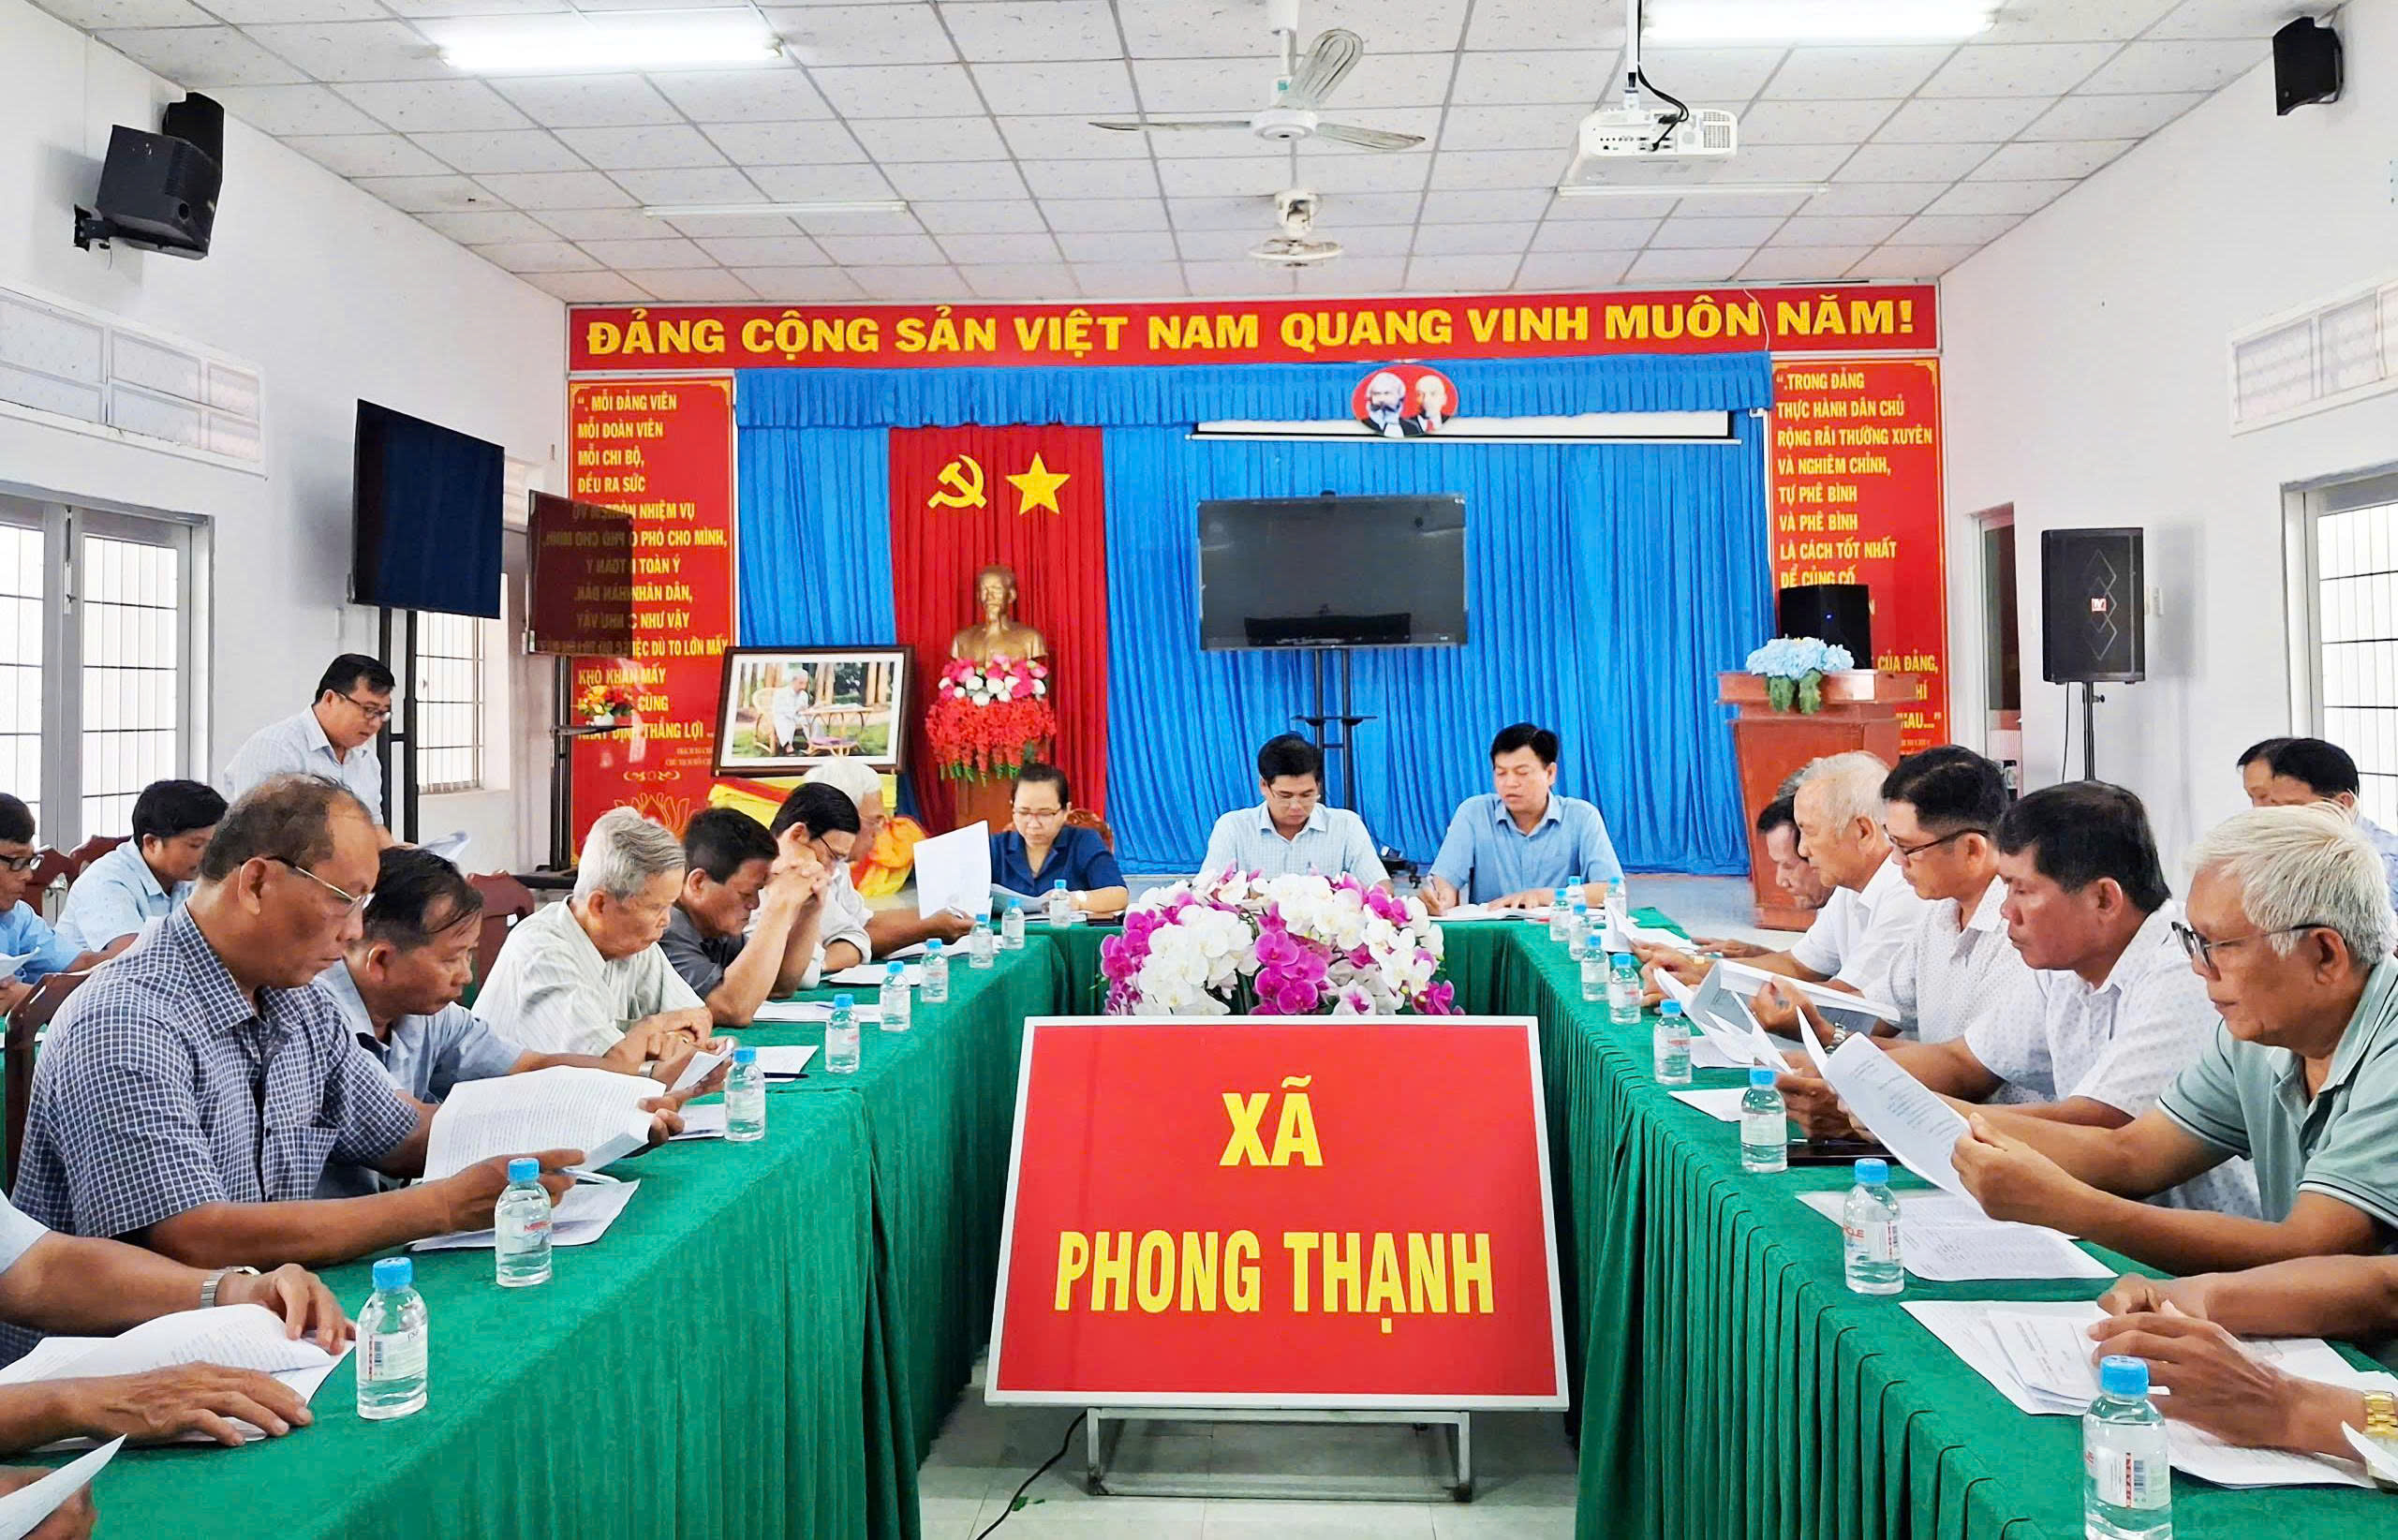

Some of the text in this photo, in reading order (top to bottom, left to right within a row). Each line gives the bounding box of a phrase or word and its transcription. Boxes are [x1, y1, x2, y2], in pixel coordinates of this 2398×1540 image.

[587, 293, 1915, 361] ĐẢNG CỘNG SẢN VIỆT NAM QUANG VINH MUÔN NĂM!
[1831, 367, 1865, 390] ĐẢNG
[615, 390, 647, 411] ĐẢNG
[650, 391, 676, 410] VIÊN
[1776, 393, 1904, 422] THỰC HÀNH DÂN CHỦ
[637, 419, 663, 437] VIÊN
[1778, 426, 1812, 450] RỘNG
[1892, 424, 1932, 444] XUYÊN
[602, 450, 621, 465] CHI
[625, 445, 644, 467] BỘ,
[1778, 454, 1795, 475] VÀ
[1798, 454, 1845, 475] NGHIÊM
[604, 477, 620, 492] RA
[623, 473, 645, 493] SỨC
[1779, 482, 1858, 506] TỰ PHÊ BÌNH
[640, 499, 676, 522] NHIỆM
[1780, 510, 1858, 532] VÀ PHÊ BÌNH
[668, 530, 691, 546] CHO
[694, 529, 728, 547] MÌNH,
[1781, 536, 1897, 560] LÀ CÁCH TỐT NHẤT
[640, 553, 669, 574] TOÀN
[632, 581, 693, 603] NHÂN DÂN,
[641, 612, 665, 629] NHƯ
[667, 609, 689, 631] VẬY
[632, 637, 649, 659] IỆC
[652, 637, 666, 655] DÙ
[668, 640, 682, 655] TO
[1219, 1075, 1323, 1166] XÃ
[1055, 1230, 1494, 1334] PHONG THẠNH
